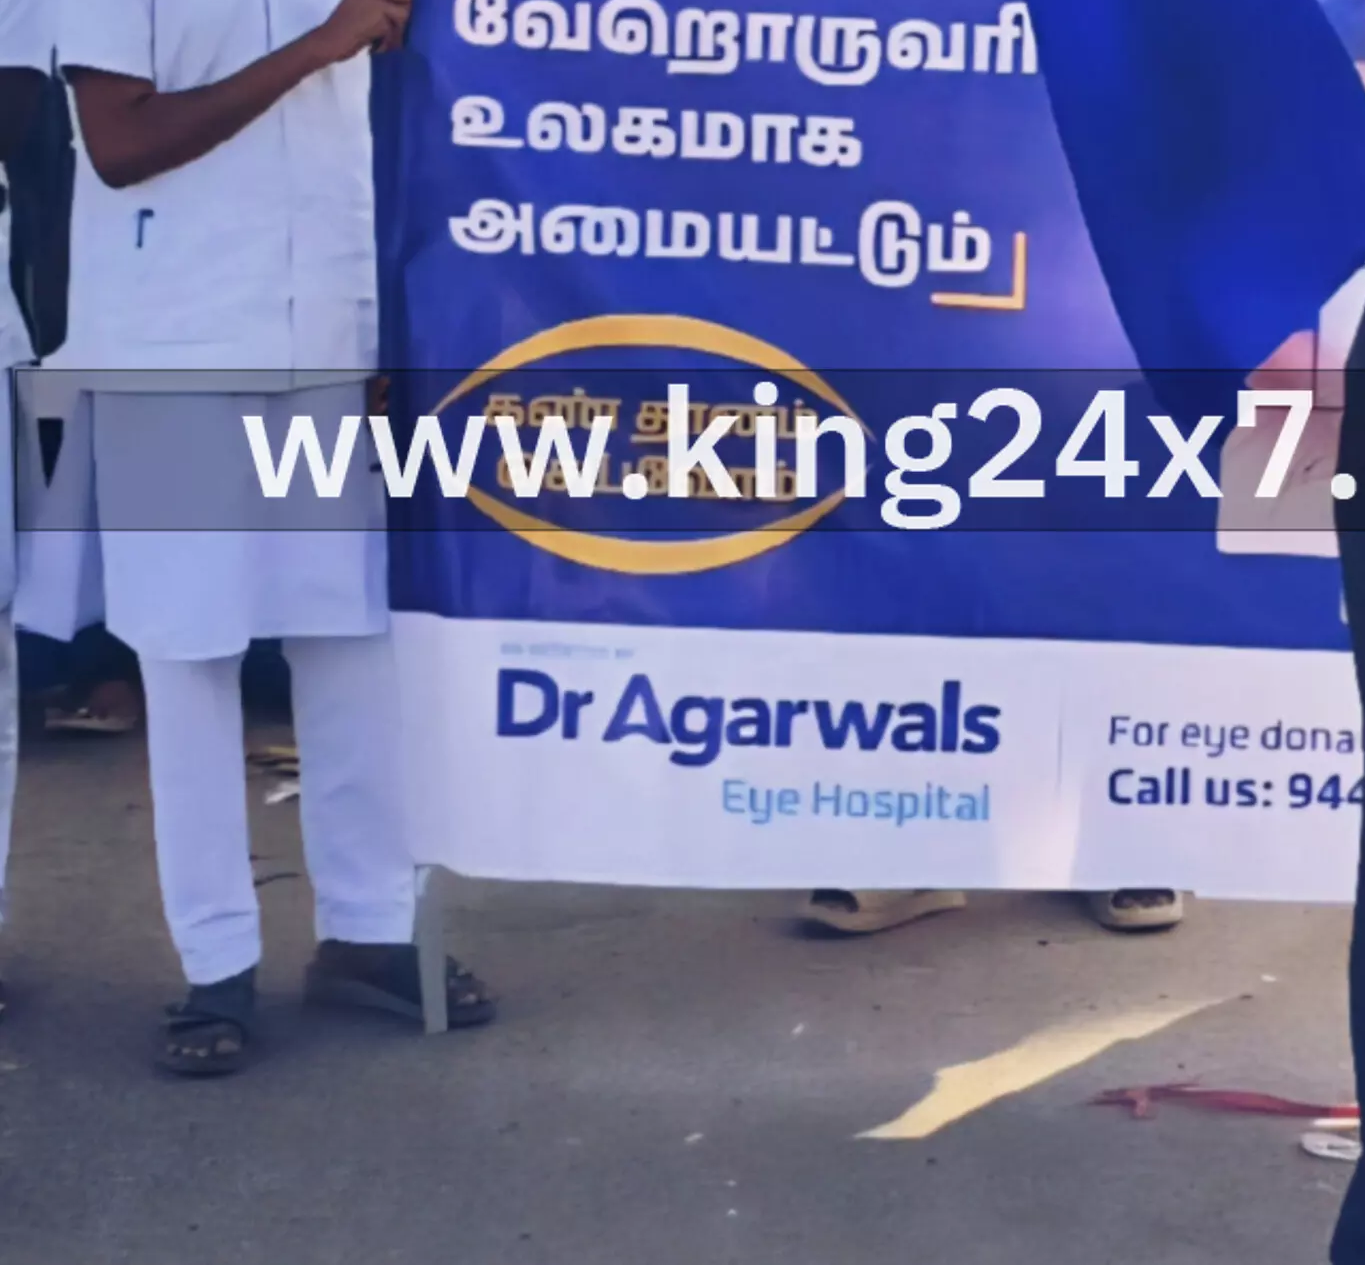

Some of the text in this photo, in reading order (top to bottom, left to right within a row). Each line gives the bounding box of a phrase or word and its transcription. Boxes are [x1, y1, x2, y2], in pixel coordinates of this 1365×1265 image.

[450, 95, 863, 168] உலகமாக
[448, 198, 992, 287] அமையட்டும்
[496, 668, 1002, 767] Dr Agarwals
[1108, 715, 1169, 748] For
[1180, 721, 1250, 758] eye
[1260, 719, 1356, 754] dona
[722, 779, 992, 828] Eye Hospital
[1108, 766, 1191, 806] Call
[1204, 777, 1273, 807] us:
